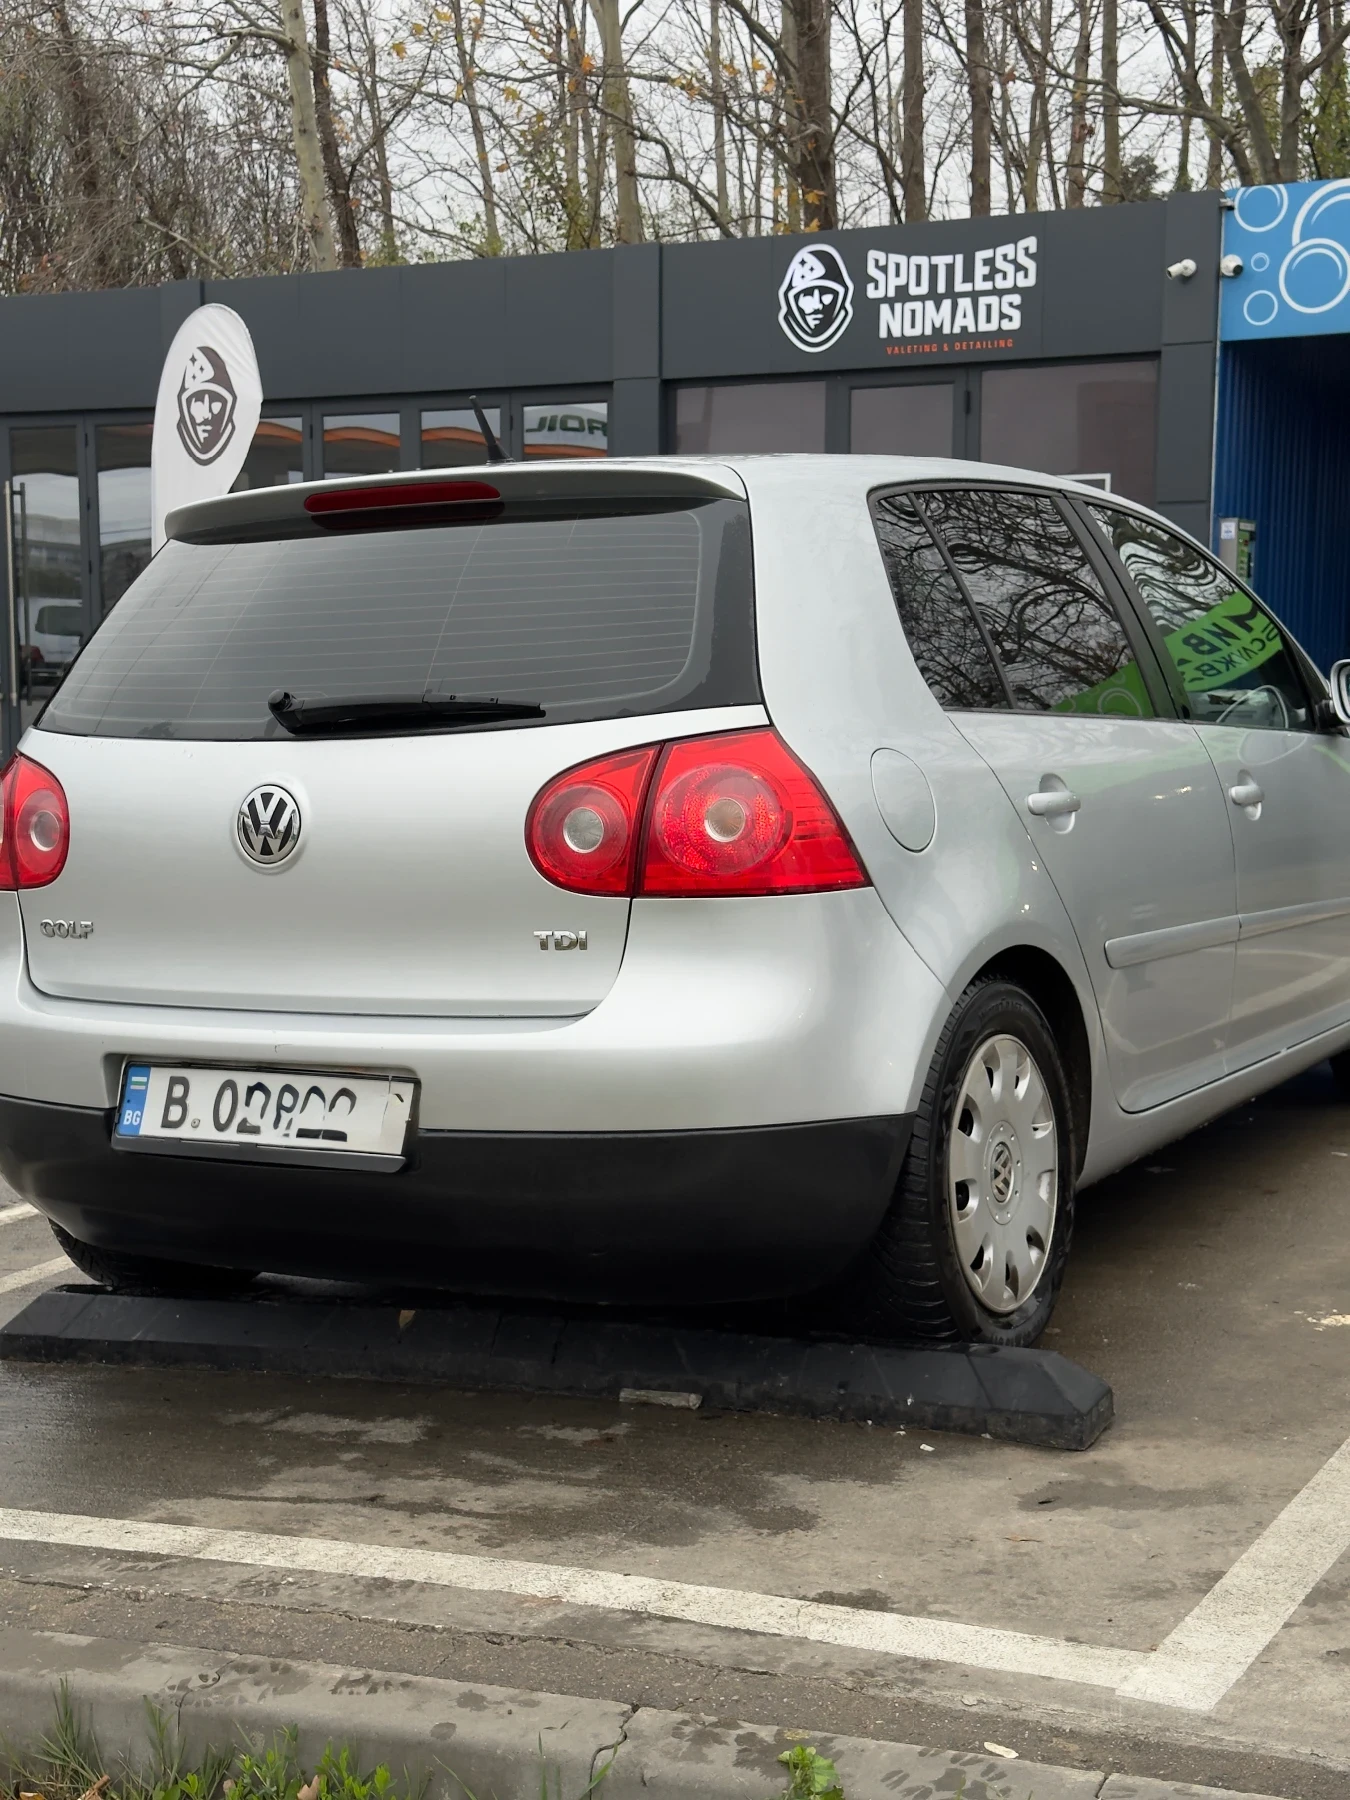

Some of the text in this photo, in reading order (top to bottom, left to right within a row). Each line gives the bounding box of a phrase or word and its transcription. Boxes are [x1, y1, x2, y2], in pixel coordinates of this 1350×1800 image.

[866, 236, 1037, 299] SPOTLESS
[879, 294, 1022, 339] NOMADS
[886, 338, 1014, 355] VALETING & DETAILING
[40, 919, 94, 939] GOLF
[533, 930, 588, 951] TDI
[123, 1109, 142, 1126] BG
